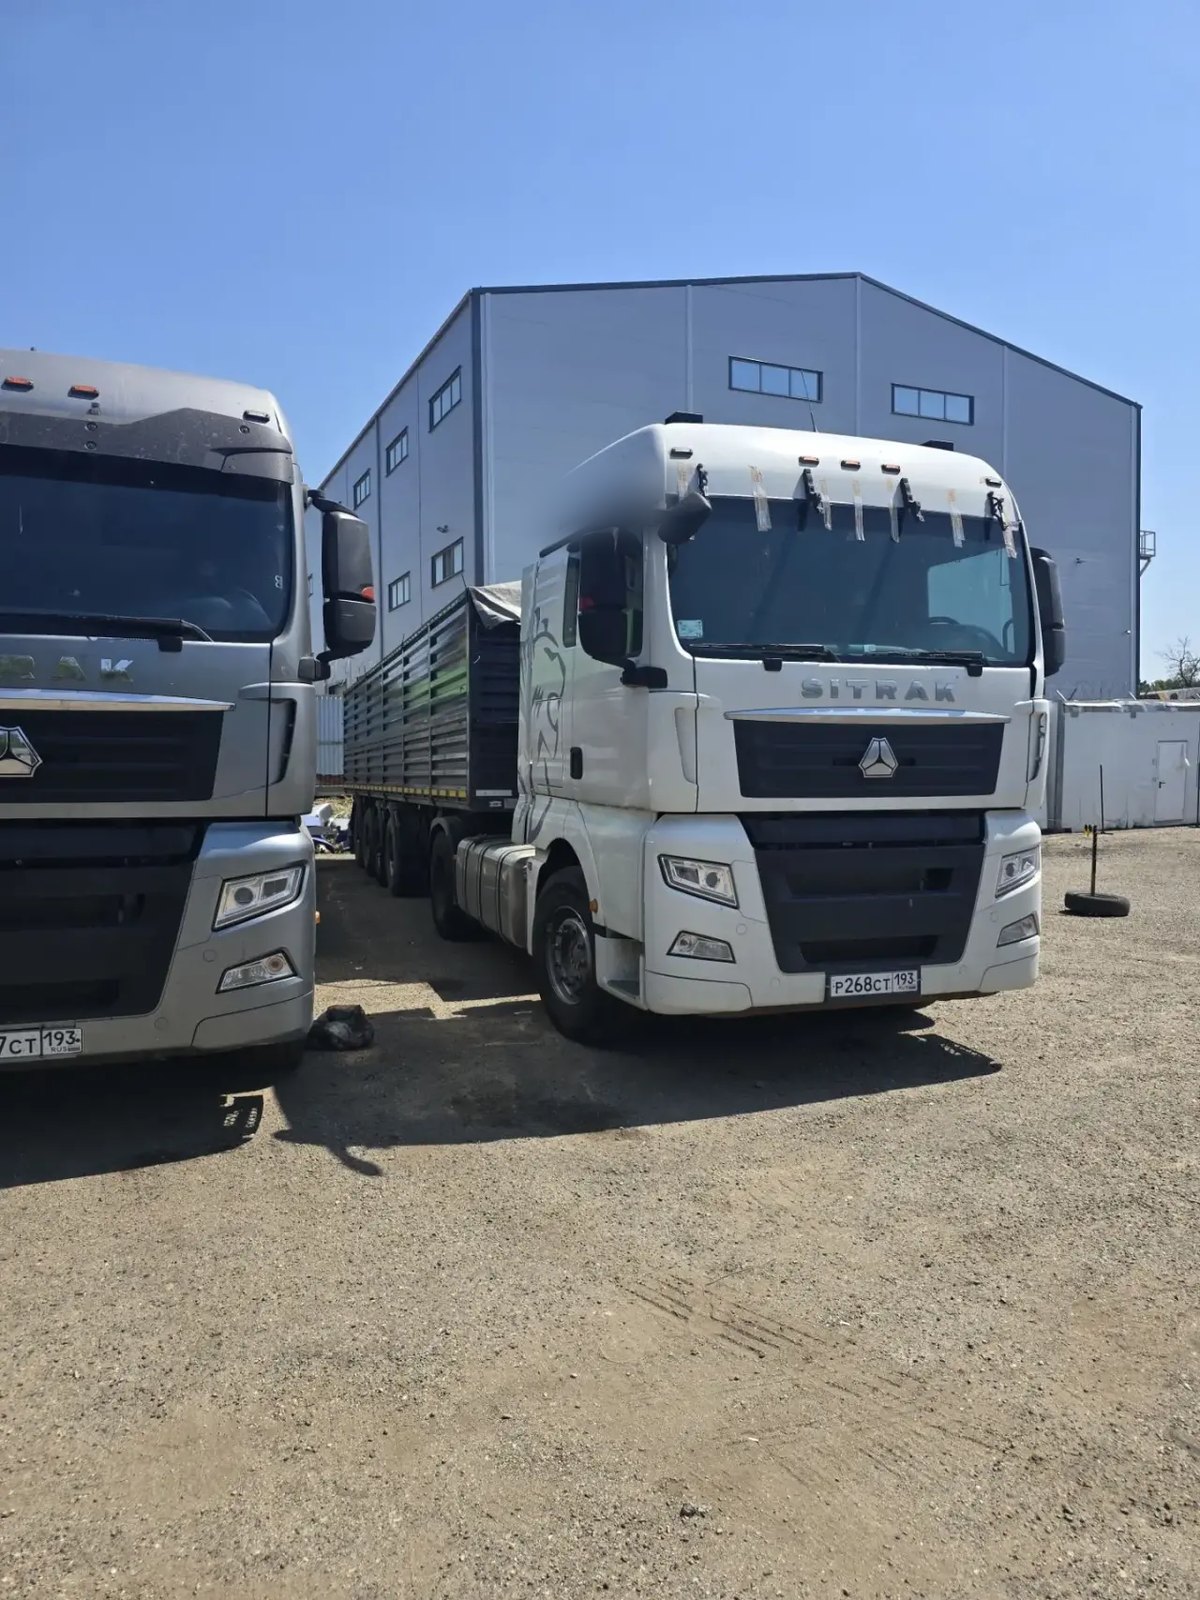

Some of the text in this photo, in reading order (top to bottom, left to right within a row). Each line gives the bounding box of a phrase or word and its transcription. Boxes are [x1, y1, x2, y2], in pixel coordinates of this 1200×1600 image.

[801, 678, 956, 702] SITRAK
[894, 972, 914, 985] 193
[43, 1031, 76, 1046] 193
